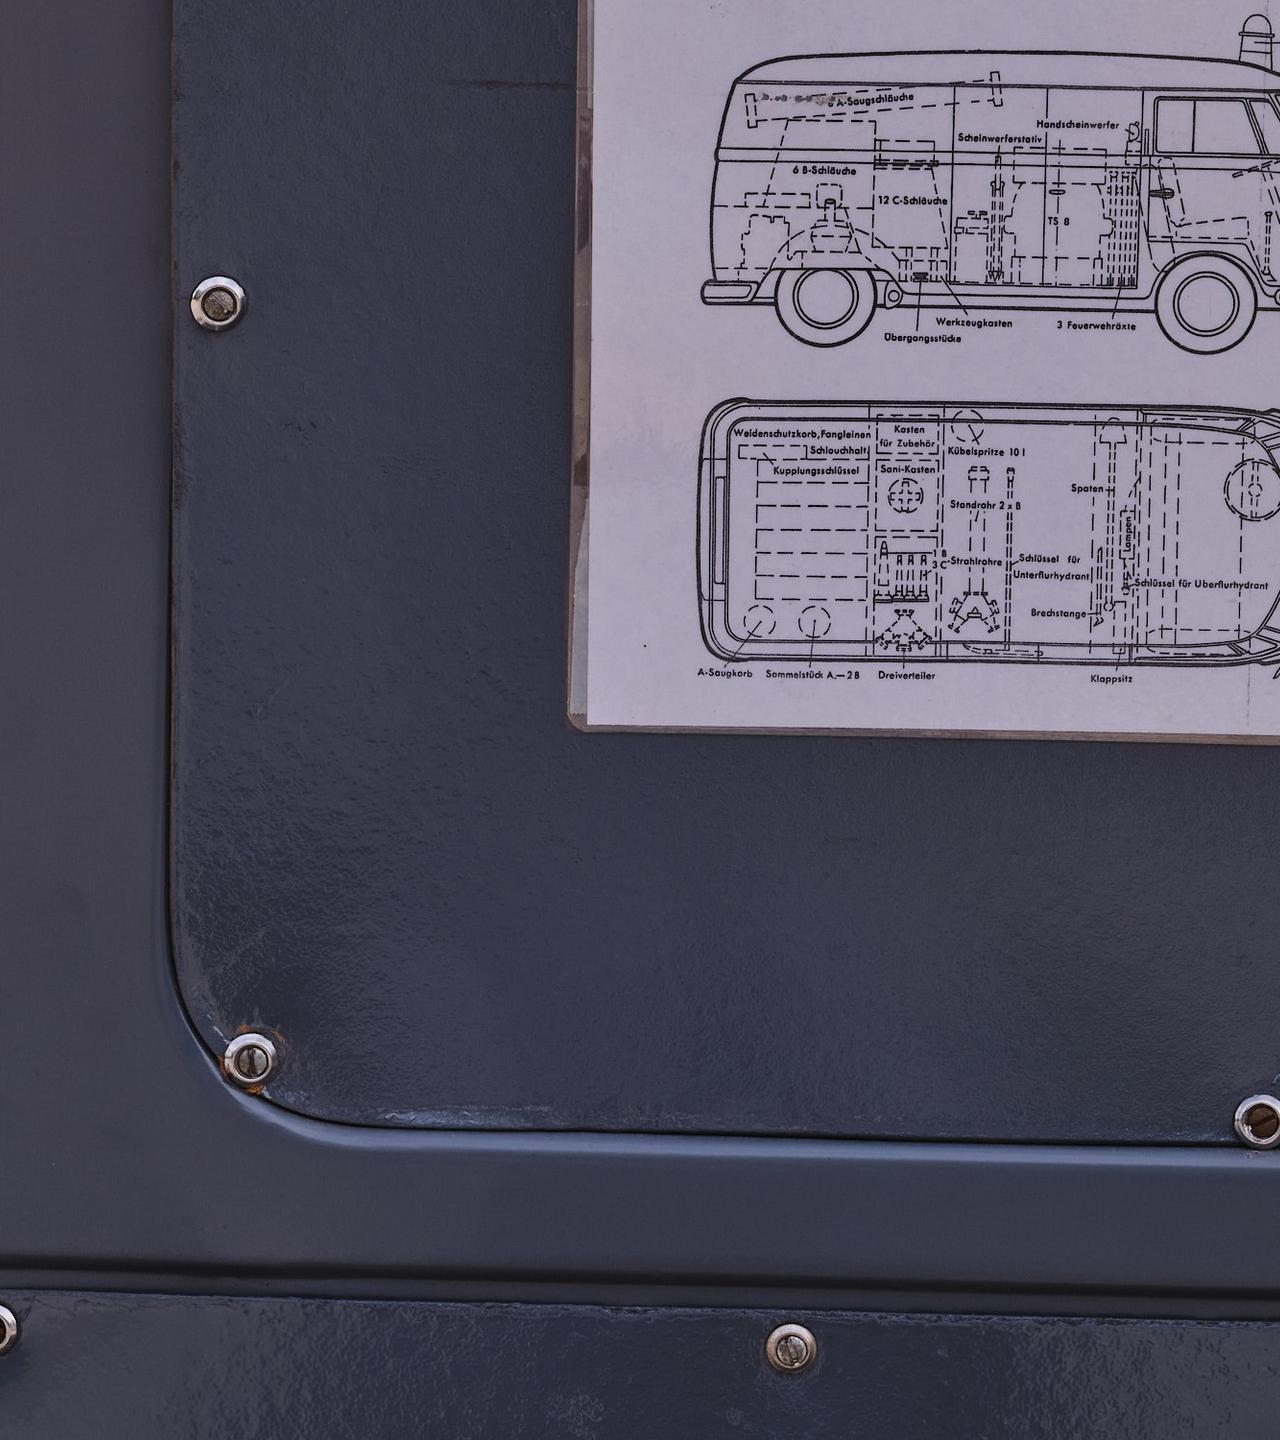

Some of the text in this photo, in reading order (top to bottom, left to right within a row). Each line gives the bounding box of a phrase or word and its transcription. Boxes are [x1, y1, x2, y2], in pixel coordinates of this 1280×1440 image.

[1036, 119, 1120, 130] Handscheinwerfer
[958, 133, 1042, 143] Scheinwerferstativ
[792, 165, 857, 176] 6 B-Schläuche
[877, 194, 948, 206] 12 C-Schläuche
[1047, 216, 1071, 227] TS 8
[935, 317, 1013, 330] Werkzeugkasten
[1056, 319, 1063, 330] 3
[883, 332, 962, 345] Übergangsstücke
[894, 424, 925, 434] Kasten
[880, 438, 935, 448] für Zubehör
[947, 447, 1005, 458] Kübelspritze
[773, 465, 860, 477] Kupplungsschlüssel
[880, 465, 935, 474] Sani-Kasten
[1071, 484, 1104, 495] Spaten
[950, 500, 996, 509] Standrohr
[1123, 516, 1135, 552] Lampen
[1019, 554, 1080, 564] Schlüssel für
[1013, 571, 1090, 582] Unterflurhydrant
[1135, 579, 1175, 588] Schlüssel
[1179, 579, 1192, 588] für
[1031, 609, 1086, 620] Brechstange
[698, 668, 752, 679] A-Saugkorb
[766, 670, 823, 679] Sammelstück
[878, 670, 936, 681] Dreiverteiler
[1090, 674, 1133, 685] Klappsitz
